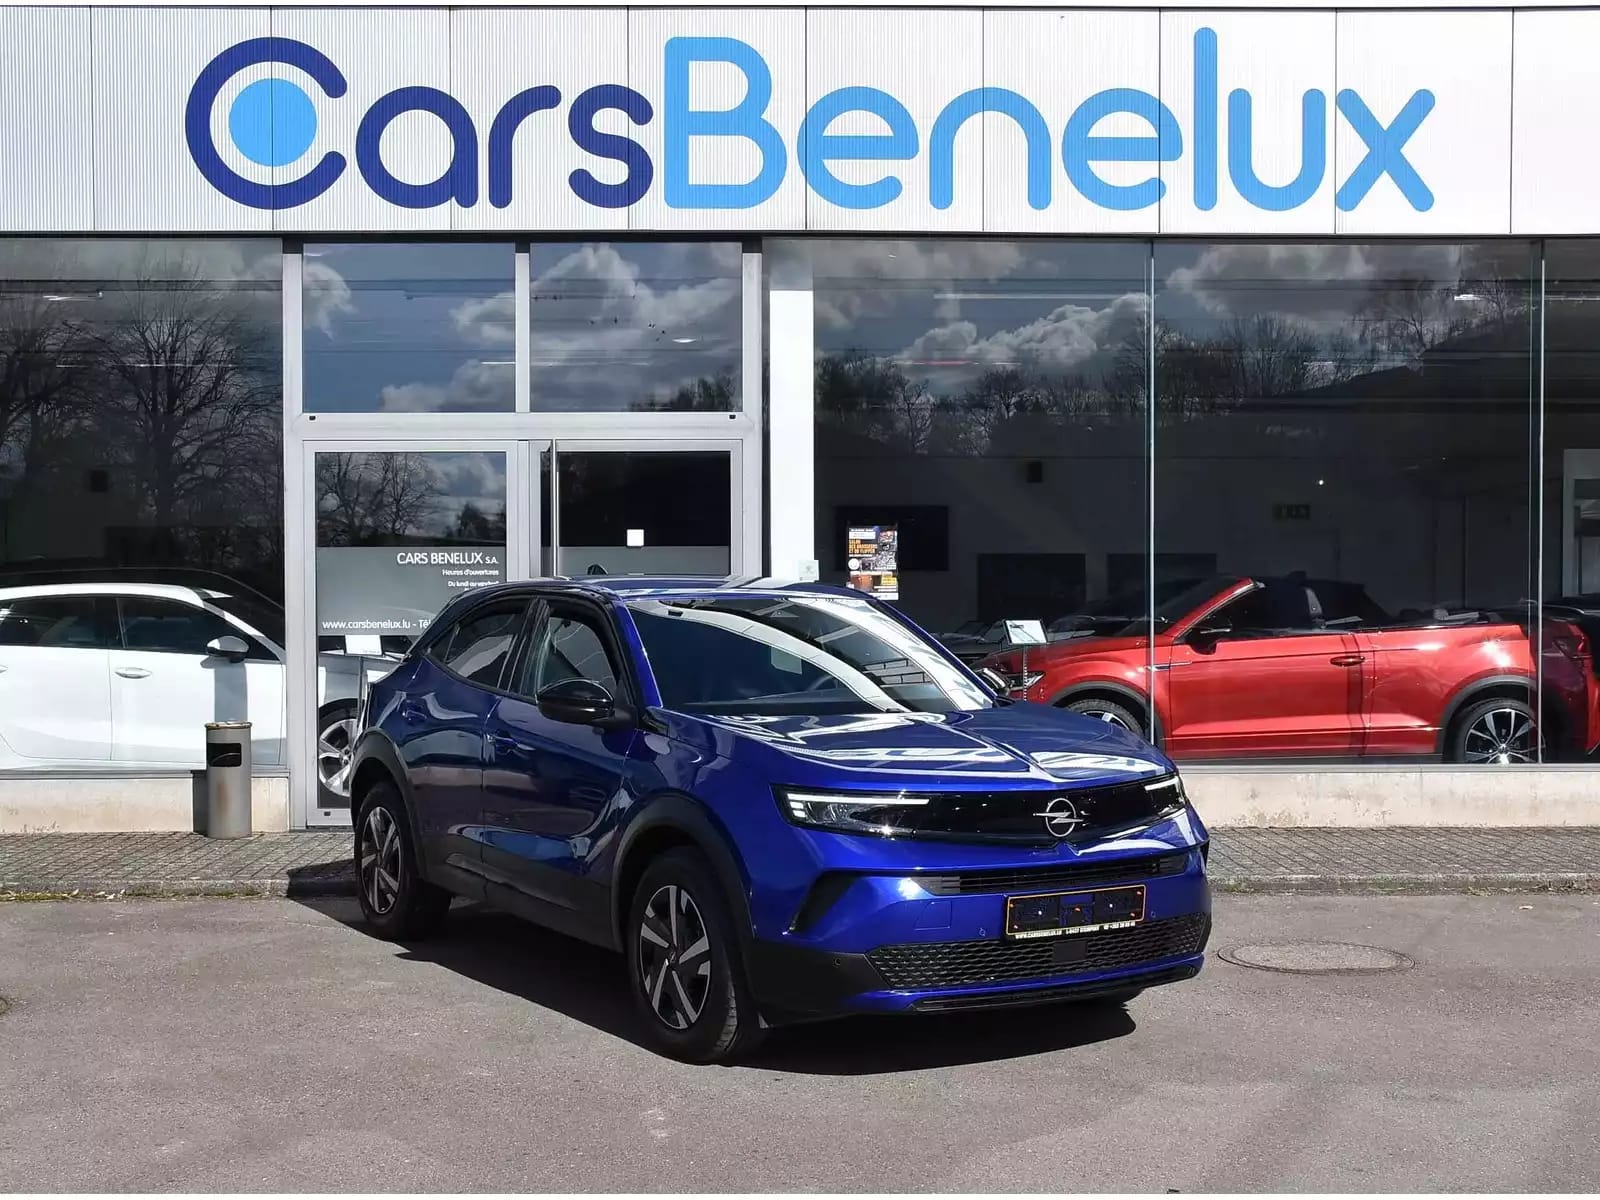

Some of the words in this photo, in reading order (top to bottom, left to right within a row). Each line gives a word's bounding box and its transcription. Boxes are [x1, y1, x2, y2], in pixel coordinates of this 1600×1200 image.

[185, 27, 1435, 212] CarsBenelux
[396, 552, 428, 565] CARS
[430, 552, 484, 565] BENELUX
[485, 556, 499, 564] S.A.
[463, 568, 499, 576] d'ouvertures
[322, 618, 411, 629] www.carsbenelux.lu
